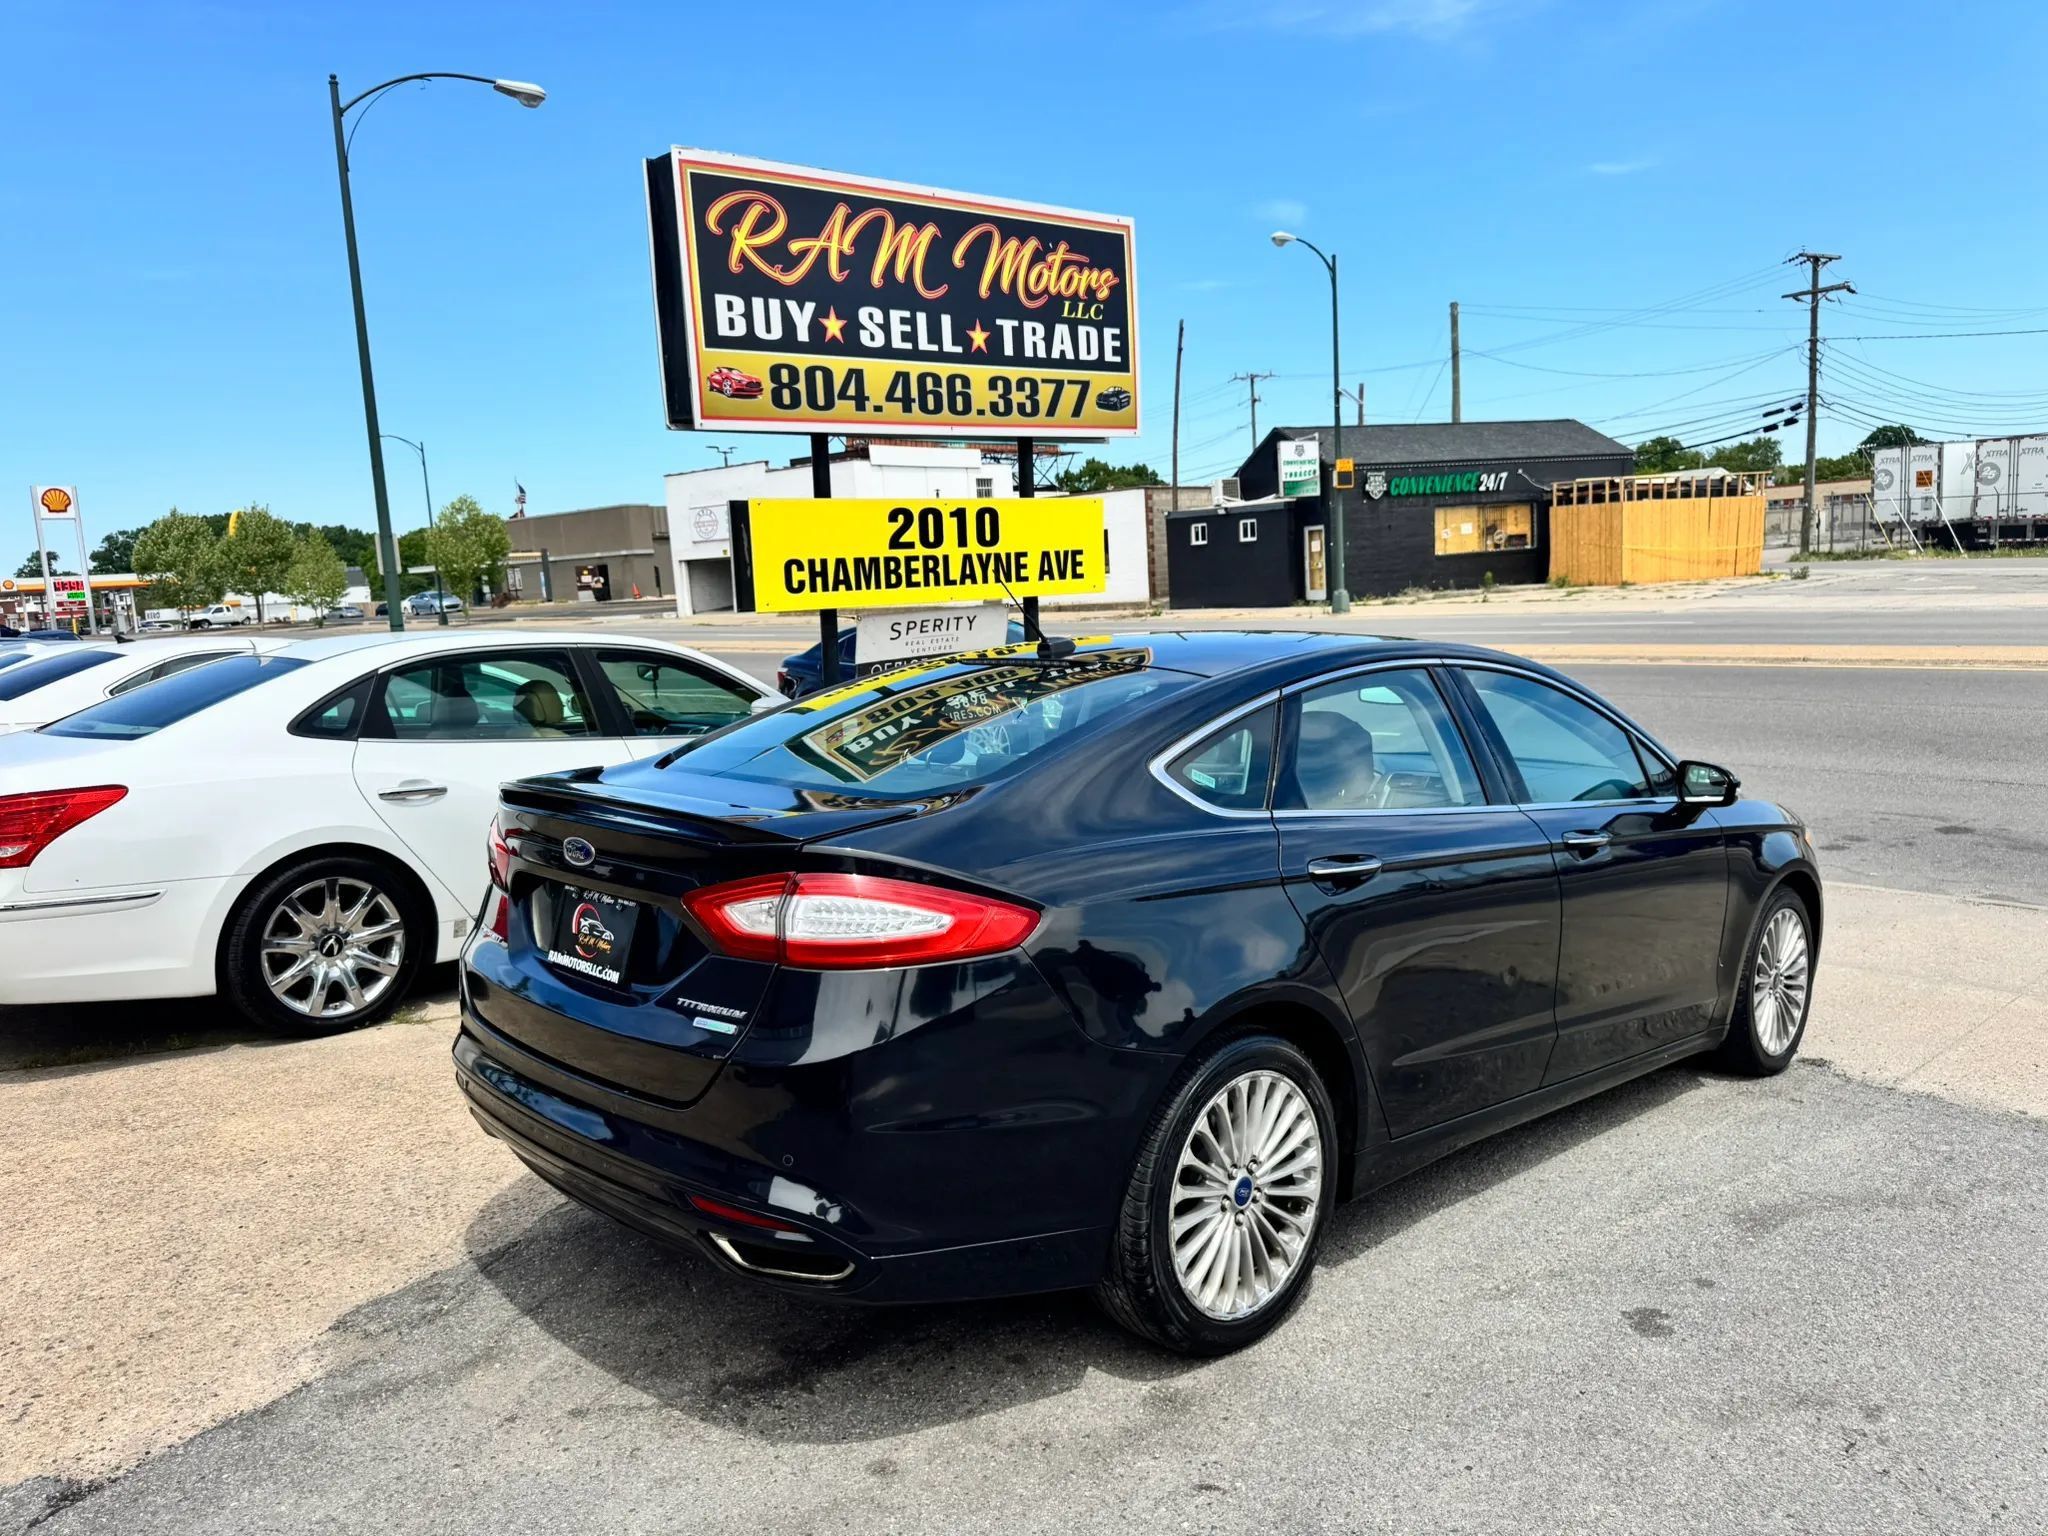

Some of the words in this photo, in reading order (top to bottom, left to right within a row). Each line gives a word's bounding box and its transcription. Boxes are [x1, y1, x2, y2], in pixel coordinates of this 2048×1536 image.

[705, 189, 948, 299] RAM
[951, 223, 1120, 309] Motors
[1060, 300, 1104, 321] LLC
[714, 293, 817, 343] BUY
[858, 305, 964, 354] SELL
[995, 318, 1122, 363] TRADE
[769, 363, 1092, 419] 804.466.3377
[1983, 449, 2008, 459] XTRA
[2019, 447, 2044, 457] XTRA
[1390, 472, 1479, 496] CONVENIENCE
[1478, 472, 1509, 492] 24/7
[887, 506, 1001, 550] 2010
[783, 550, 1029, 595] CHAMBERLAYNE
[1038, 548, 1085, 581] AVE
[889, 615, 977, 641] SPERITY
[905, 639, 926, 647] REAL
[930, 636, 960, 645] ESTATE
[910, 645, 953, 653] VENTURES
[548, 949, 620, 984] RAMMOTORSLLC.COM
